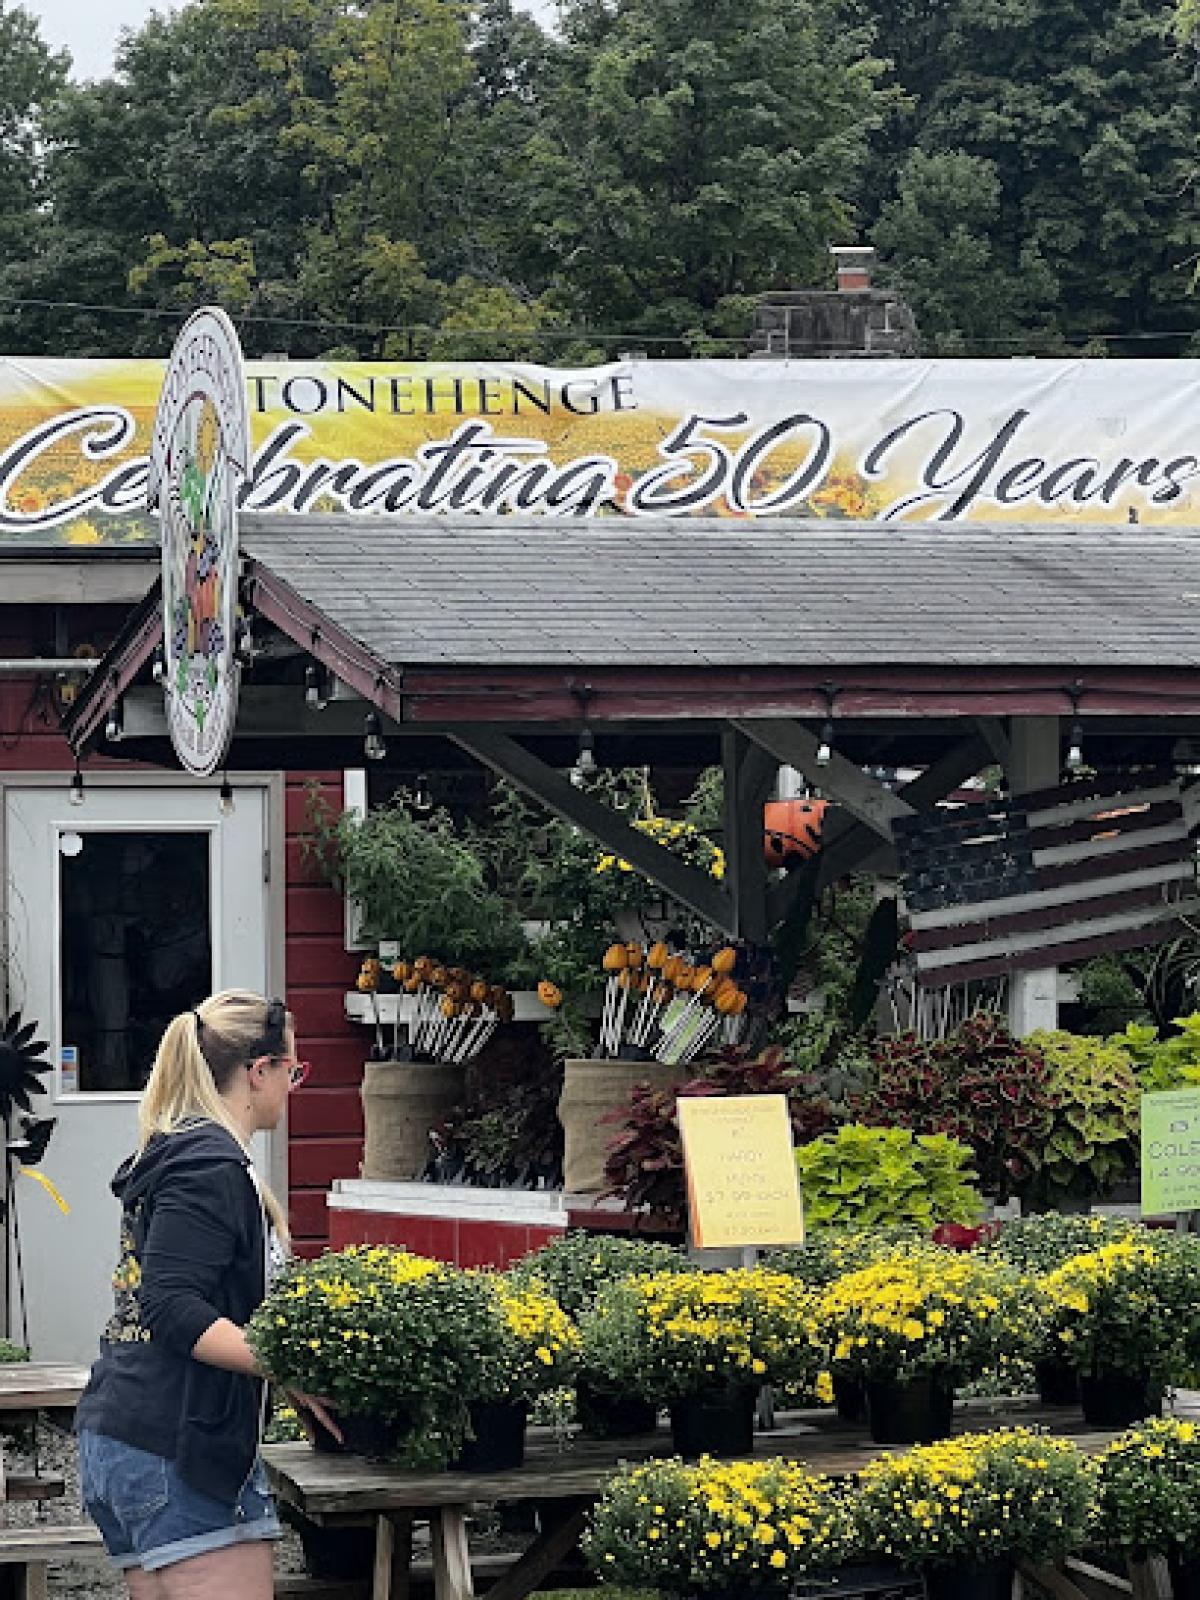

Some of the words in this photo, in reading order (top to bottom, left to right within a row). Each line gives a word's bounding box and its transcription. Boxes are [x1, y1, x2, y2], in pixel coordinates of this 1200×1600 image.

[246, 374, 639, 415] TONEHENGE
[0, 410, 628, 524] Cebrating
[633, 411, 830, 510] 50
[864, 408, 1198, 521] Years
